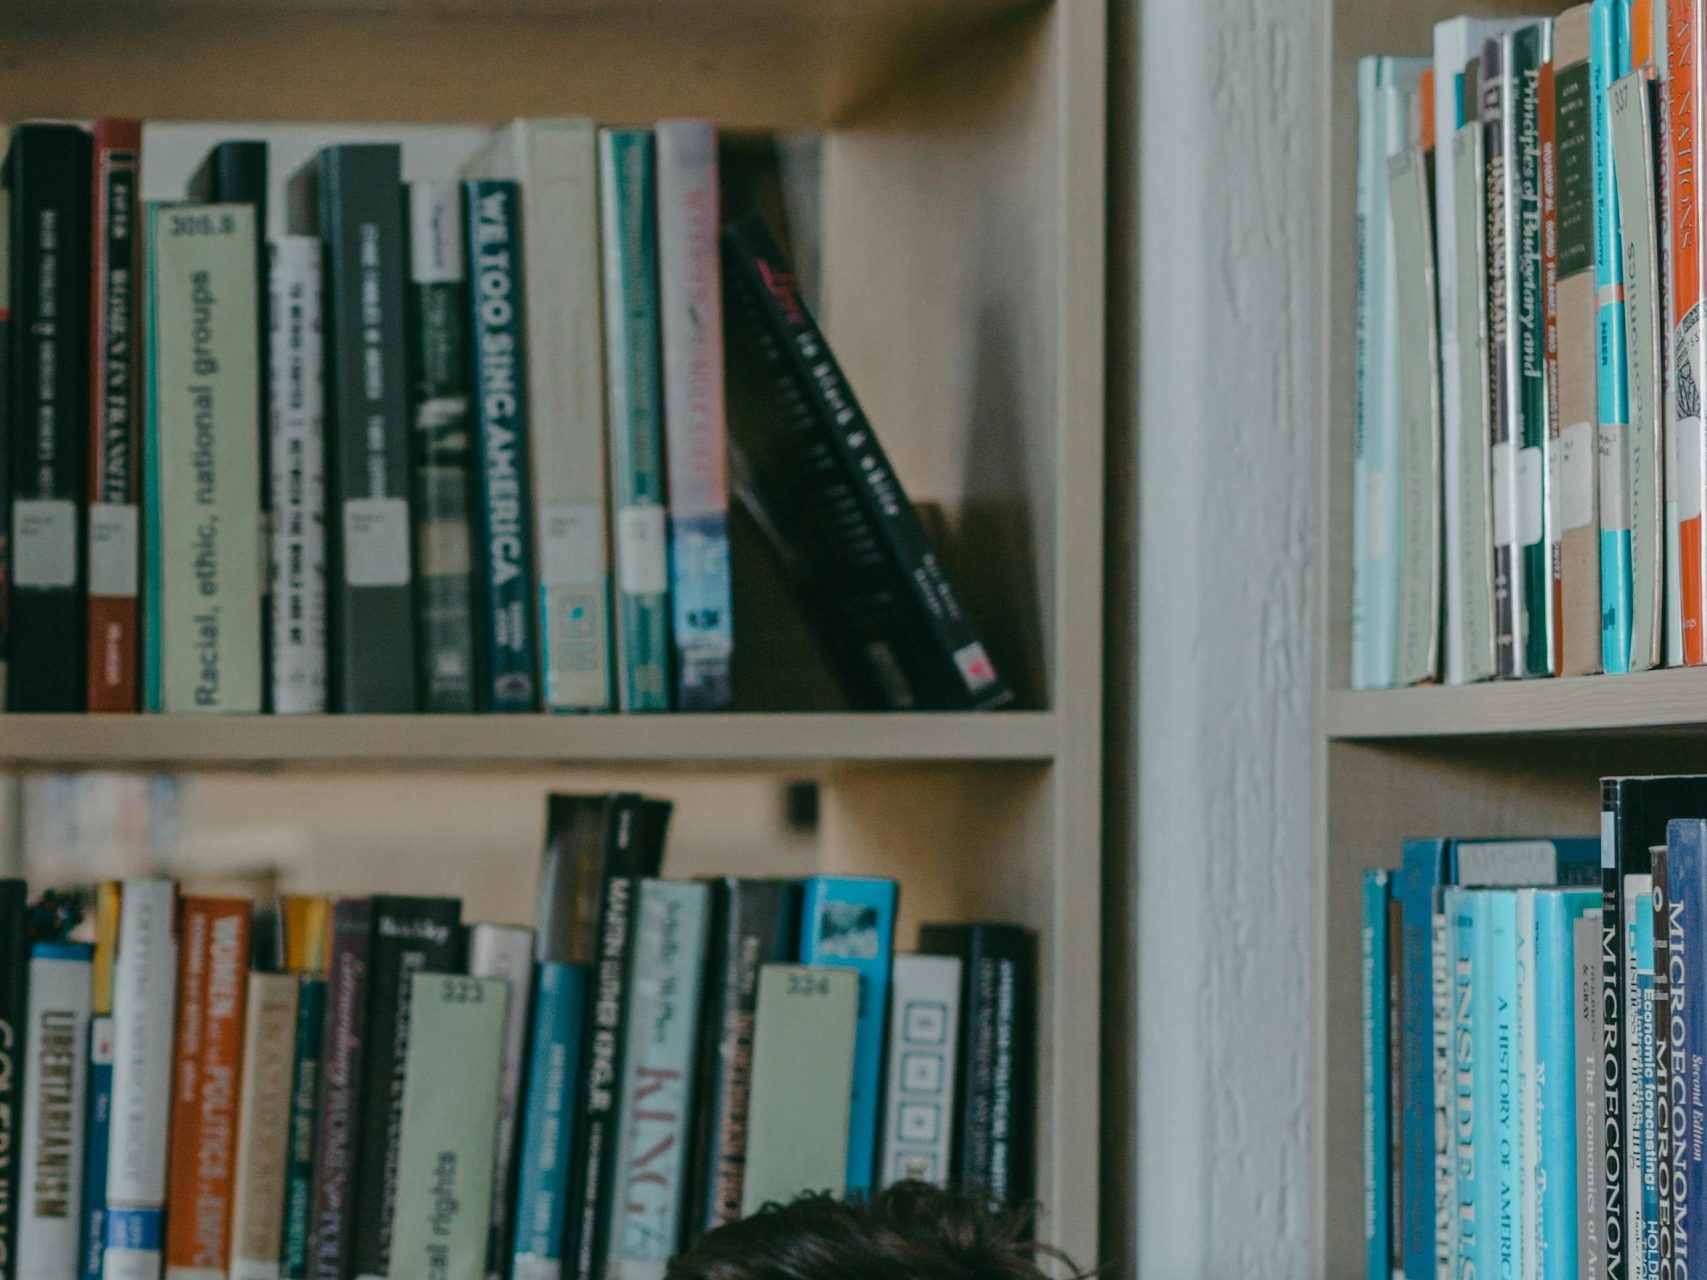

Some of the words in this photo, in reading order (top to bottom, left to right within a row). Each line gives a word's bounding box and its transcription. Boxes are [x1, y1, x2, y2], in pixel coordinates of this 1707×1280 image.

[1519, 70, 1541, 178] Principles
[1594, 94, 1603, 139] Policy
[1596, 142, 1604, 169] and
[1656, 81, 1669, 234] ECONOMIC
[1520, 181, 1543, 208] of
[1597, 172, 1605, 195] the
[1678, 90, 1693, 250] NATIONS
[479, 191, 509, 245] WE
[1597, 199, 1605, 267] Economy
[481, 250, 511, 328] TOO
[1518, 211, 1542, 328] Budgetary
[189, 269, 219, 377] groups
[1522, 332, 1543, 377] and
[1600, 321, 1609, 367] NBER
[1624, 242, 1641, 431] economics
[483, 333, 514, 422] SING
[187, 384, 216, 505] national
[485, 422, 523, 587] AMERICA
[192, 514, 219, 597] ethic,
[193, 605, 220, 707] Racial,
[603, 876, 632, 958] MARTIN
[209, 915, 244, 1018] WOMEN
[1497, 995, 1509, 1012] A
[1582, 964, 1591, 977] &
[1583, 981, 1591, 1022] GRAY
[1455, 957, 1476, 1182] INSIDE
[1585, 1053, 1596, 1095] The
[1644, 987, 1655, 1078] Economic
[35, 1010, 78, 1219] LIBERTARIANISM
[1498, 1024, 1512, 1130] HISTORY
[1691, 1053, 1703, 1107] Second
[199, 1066, 236, 1178] POLITICS
[624, 1064, 683, 1220] KING
[1499, 1138, 1512, 1171] OF
[1585, 1100, 1597, 1214] Economics
[1644, 1082, 1656, 1191] forecasting:
[1692, 1109, 1704, 1164] Edition
[425, 1150, 459, 1237] rights
[1586, 1219, 1598, 1243] of
